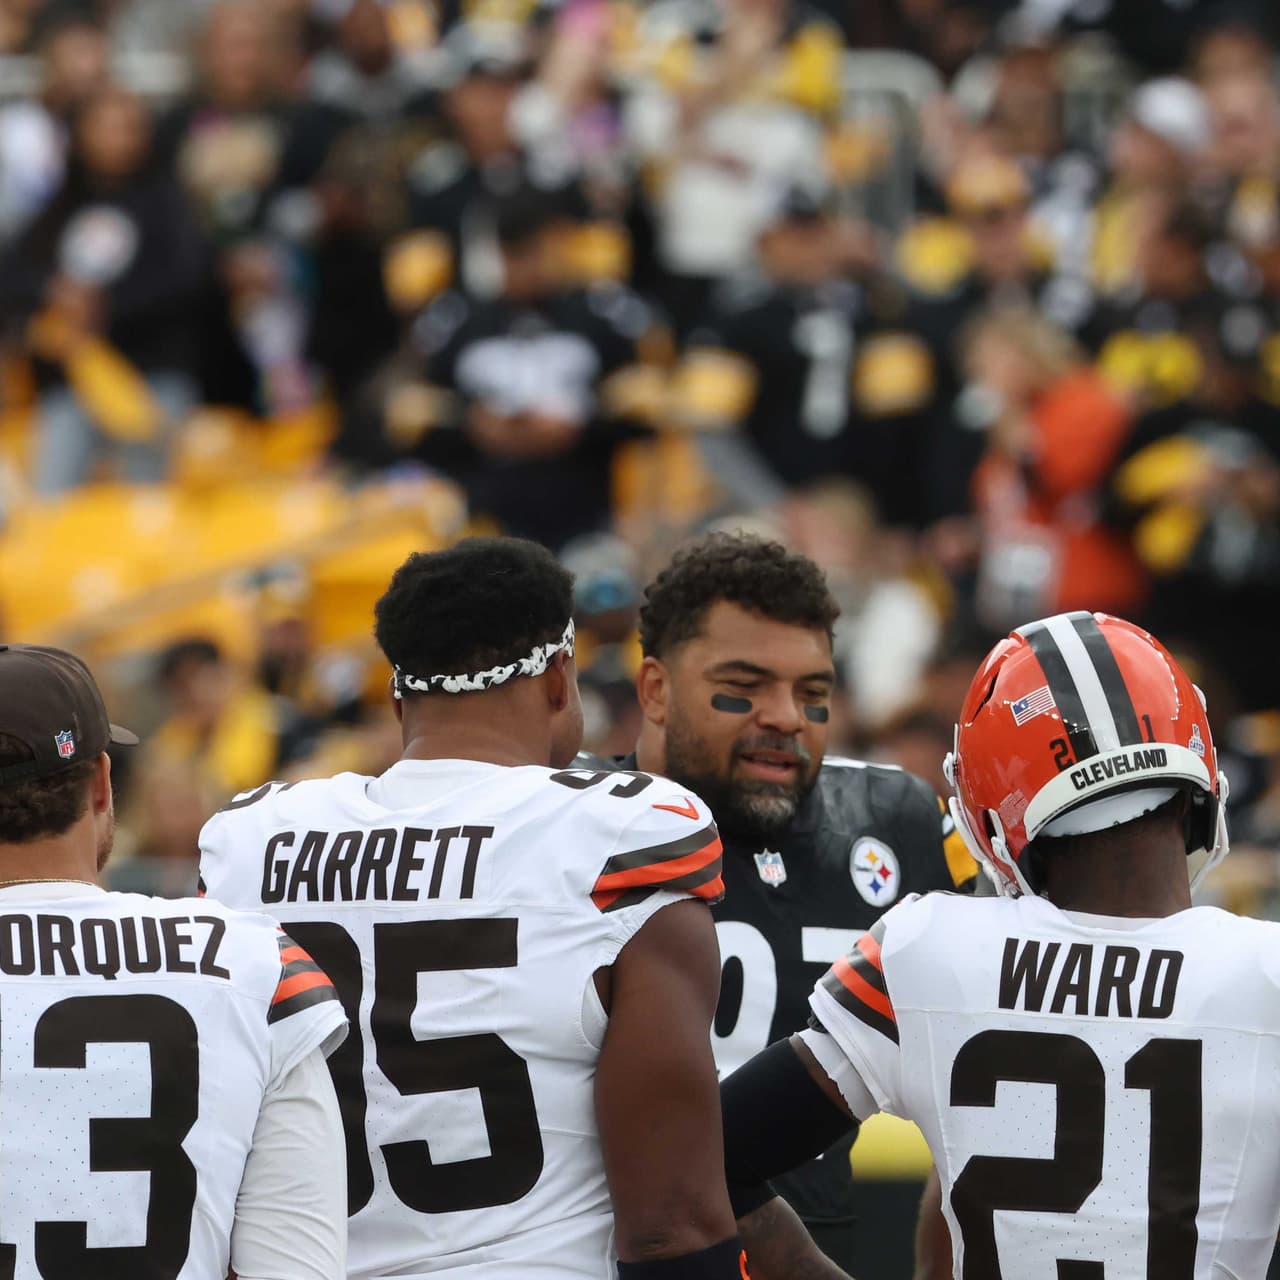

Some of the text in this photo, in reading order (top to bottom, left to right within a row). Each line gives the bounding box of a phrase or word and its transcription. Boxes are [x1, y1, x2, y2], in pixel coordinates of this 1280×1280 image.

[1070, 748, 1168, 791] CLEVELAND
[261, 825, 494, 903] GARRETT
[763, 863, 782, 879] NFL
[998, 937, 1184, 1019] WARD
